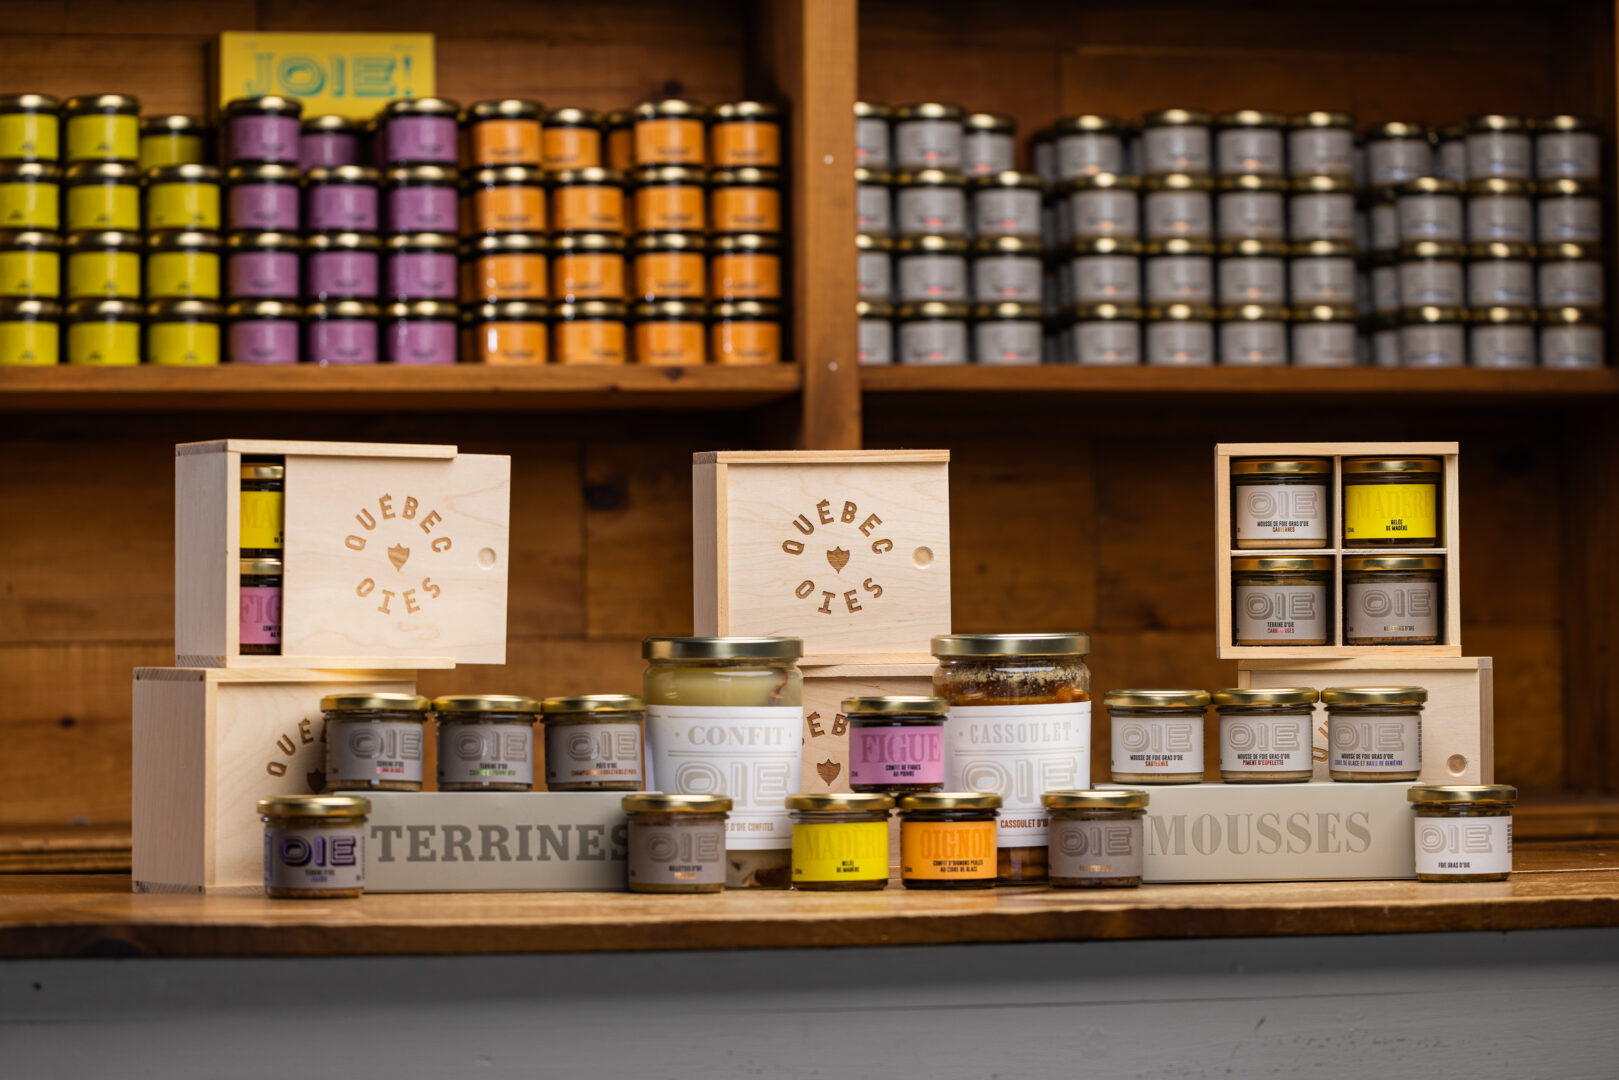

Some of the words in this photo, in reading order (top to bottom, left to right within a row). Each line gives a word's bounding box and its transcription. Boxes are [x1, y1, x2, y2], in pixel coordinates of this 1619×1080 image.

[242, 52, 413, 98] JOIE!
[1247, 490, 1318, 519] OIE
[355, 577, 441, 615] OIES
[795, 578, 883, 615] OIES
[1247, 592, 1316, 620] OIE
[1361, 588, 1431, 618] OIE
[349, 728, 421, 760] OIE
[455, 731, 527, 762] OIE
[567, 731, 637, 761] OIE
[687, 725, 785, 746] CONFIT
[860, 733, 941, 763] FIGUE
[970, 721, 1072, 744] CASSOULET
[1121, 723, 1193, 753] OIE
[1229, 722, 1300, 752] OIE
[1335, 722, 1404, 752] OIE
[675, 761, 791, 807] OIE
[962, 757, 1078, 803] OIE
[1000, 818, 1035, 828] CASSOULET
[1148, 811, 1372, 856] MOUSSES
[1421, 823, 1493, 854] OIE
[281, 835, 357, 867] OIE
[370, 824, 628, 862] TERRINES
[647, 832, 719, 863] OIE
[1061, 826, 1132, 857] OIE
